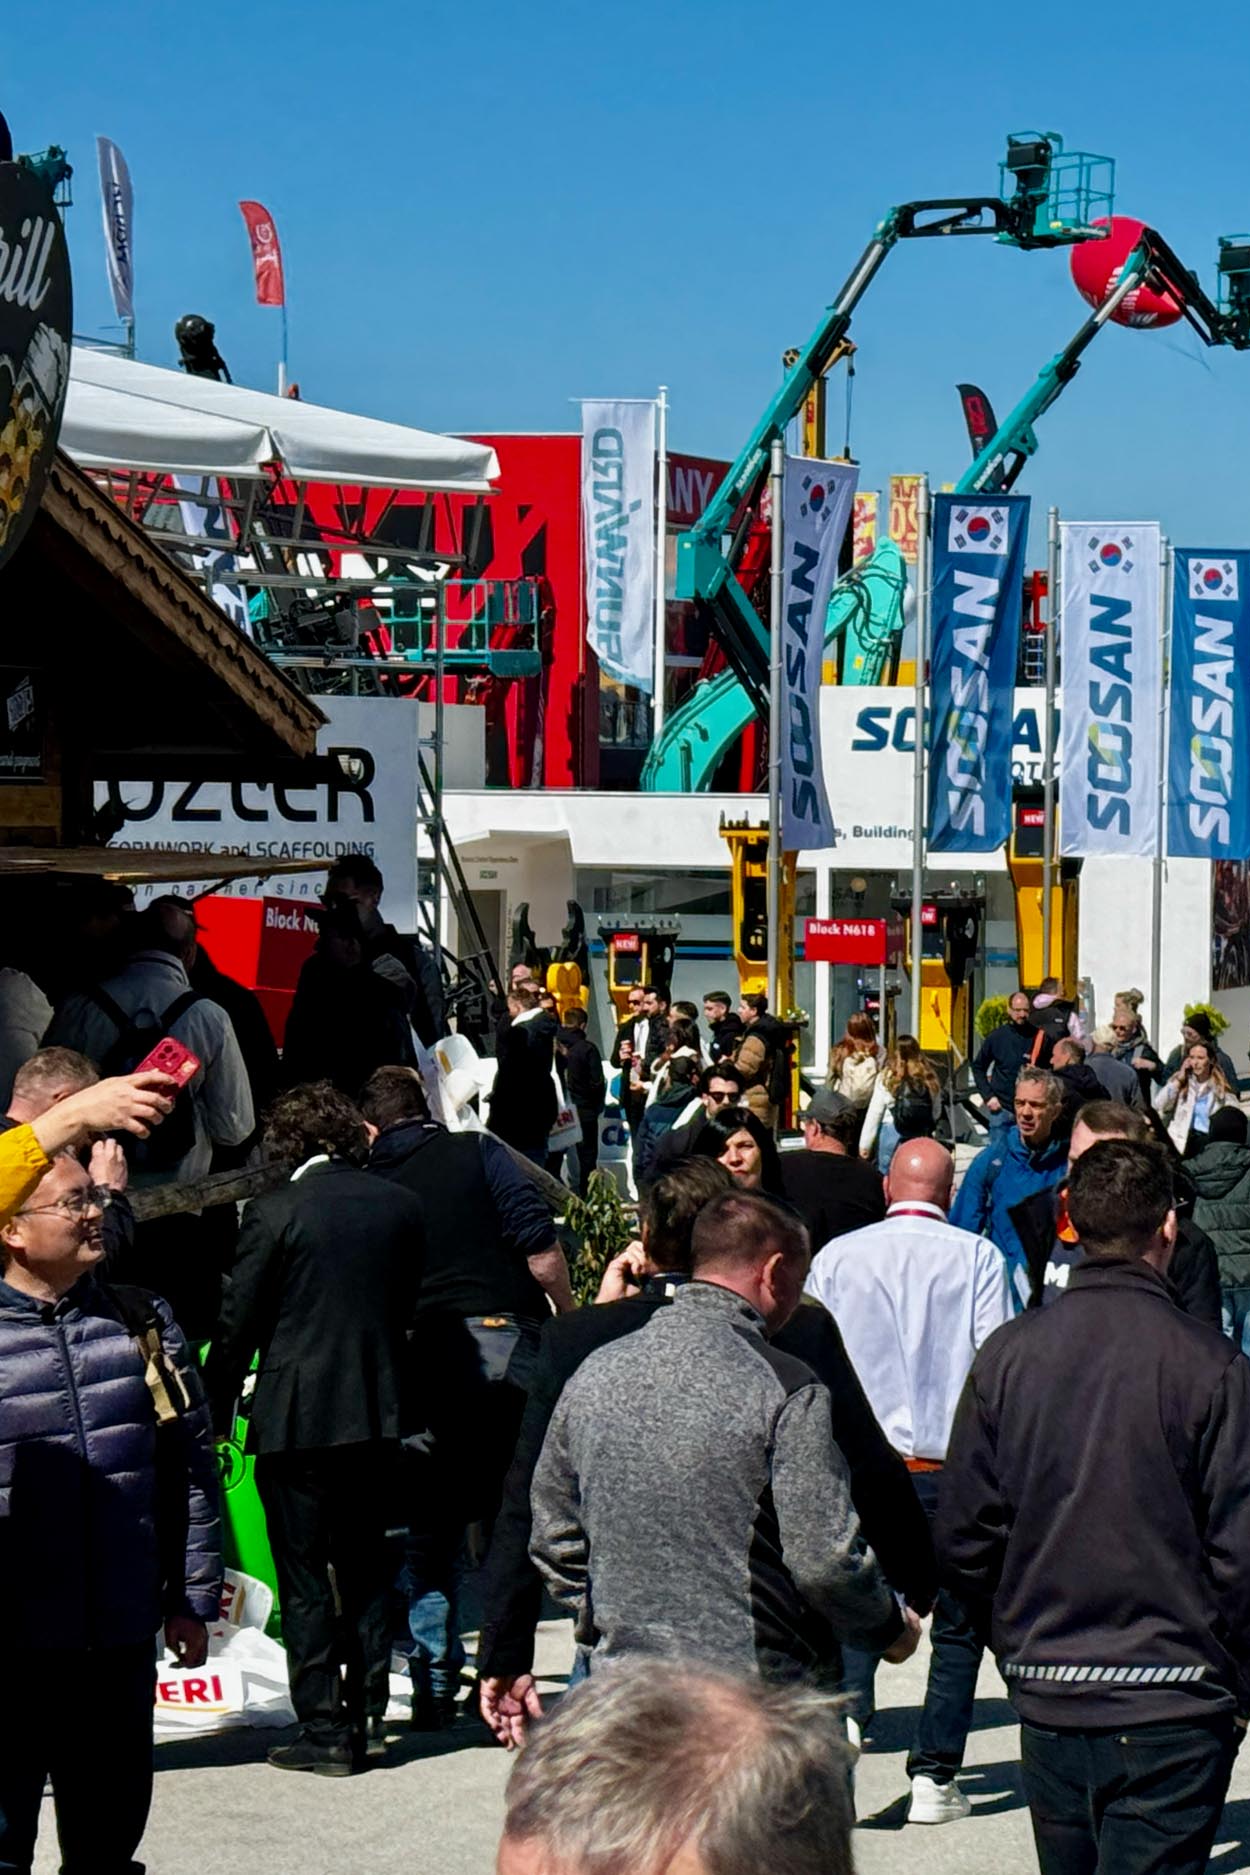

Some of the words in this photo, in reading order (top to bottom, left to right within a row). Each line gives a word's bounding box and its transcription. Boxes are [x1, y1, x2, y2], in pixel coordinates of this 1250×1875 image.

[1087, 593, 1132, 836] SOOSAN
[1189, 614, 1234, 845] SOOSAN
[256, 841, 375, 858] SCAFFOLDING
[276, 879, 323, 896] sinc
[265, 907, 300, 931] Block
[809, 922, 840, 934] Block
[158, 1675, 224, 1703] ERI
